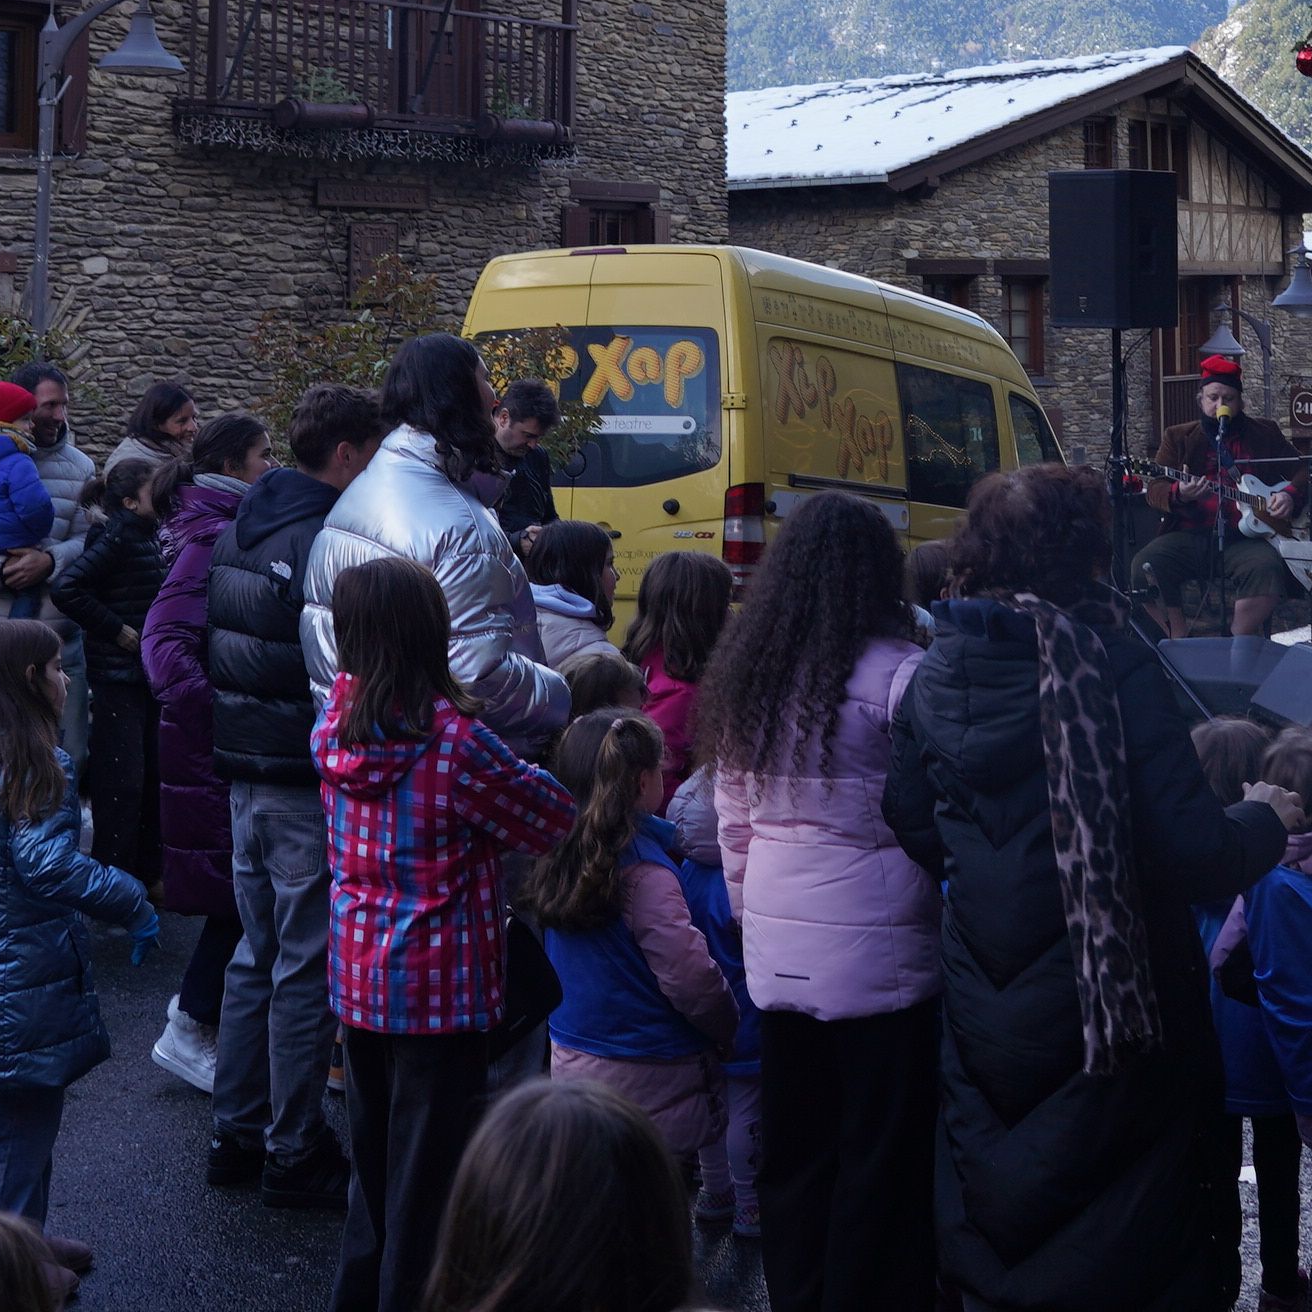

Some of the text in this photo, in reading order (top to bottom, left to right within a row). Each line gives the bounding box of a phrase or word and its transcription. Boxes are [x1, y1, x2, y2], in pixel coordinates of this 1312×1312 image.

[581, 334, 706, 408] Xap
[768, 340, 837, 430] Xip
[614, 417, 652, 430] teatre
[832, 396, 894, 482] Xap
